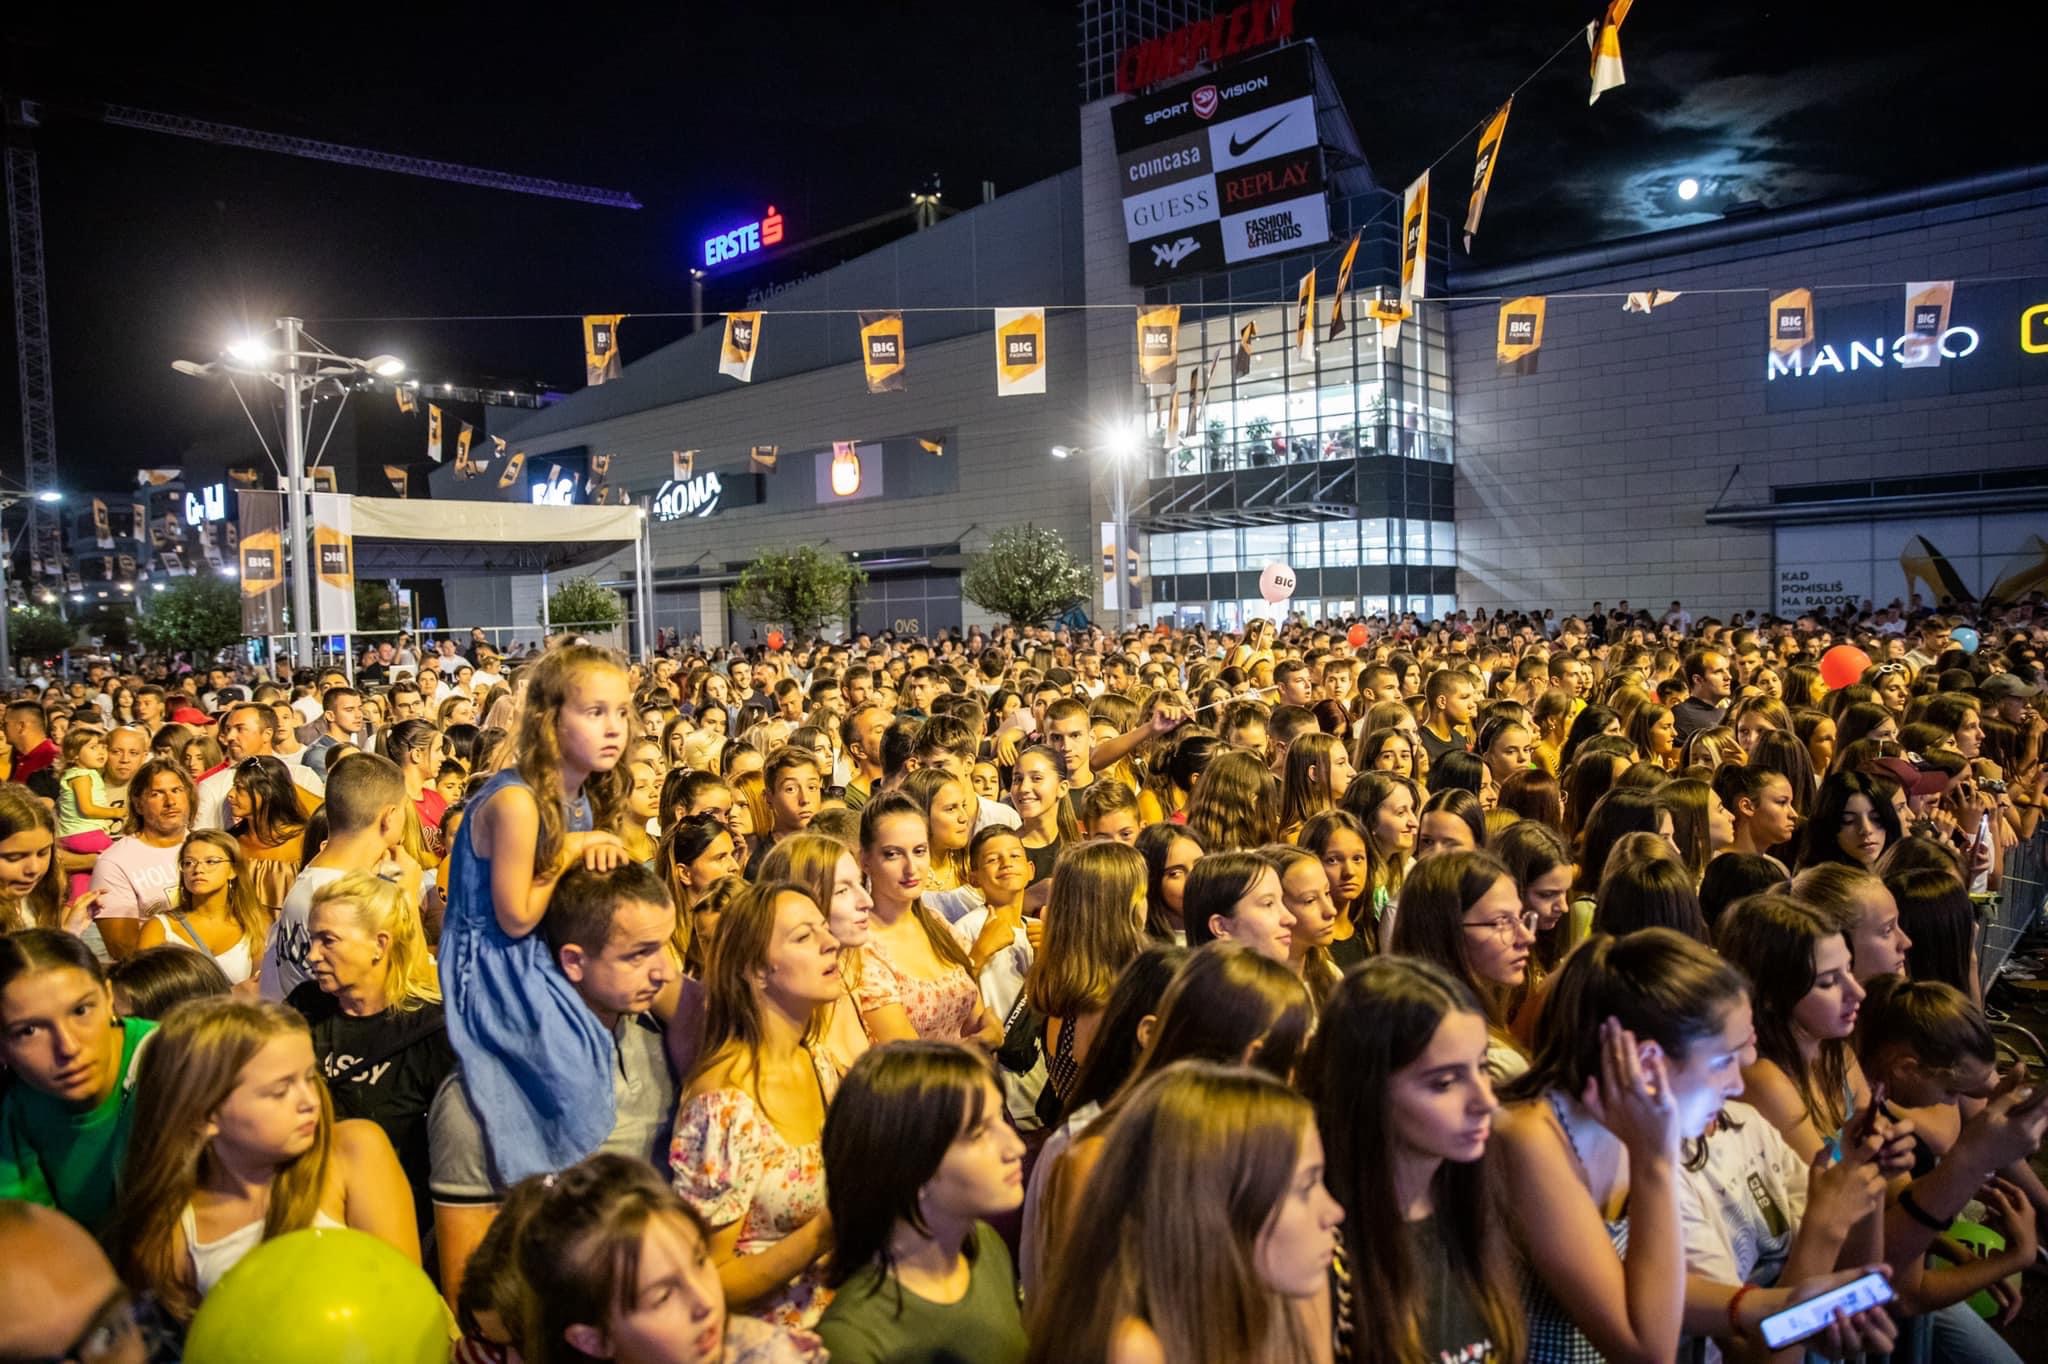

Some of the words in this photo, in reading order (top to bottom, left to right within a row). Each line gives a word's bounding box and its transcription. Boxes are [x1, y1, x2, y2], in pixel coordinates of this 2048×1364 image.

[1144, 101, 1190, 126] SPORT
[1220, 75, 1269, 101] VISION
[1129, 146, 1201, 182] coincasa
[1225, 163, 1310, 203] REPLAY
[1133, 189, 1210, 227] GUESS
[1245, 210, 1293, 236] FASHION
[705, 221, 761, 267] ERSTE
[1780, 316, 1802, 327] BIG
[1917, 313, 1936, 325] BIG
[1510, 321, 1531, 332] BIG
[1144, 333, 1168, 344] BIG
[872, 342, 896, 353] BIG
[1009, 342, 1033, 353] BIG
[1768, 326, 1980, 381] MANGO
[247, 557, 272, 568] BIG
[1781, 571, 1809, 582] KAD
[1781, 580, 1844, 594] POMISLIŠ
[1781, 597, 1801, 607] NA
[1805, 595, 1861, 606] RADOST
[895, 618, 919, 634] OVS
